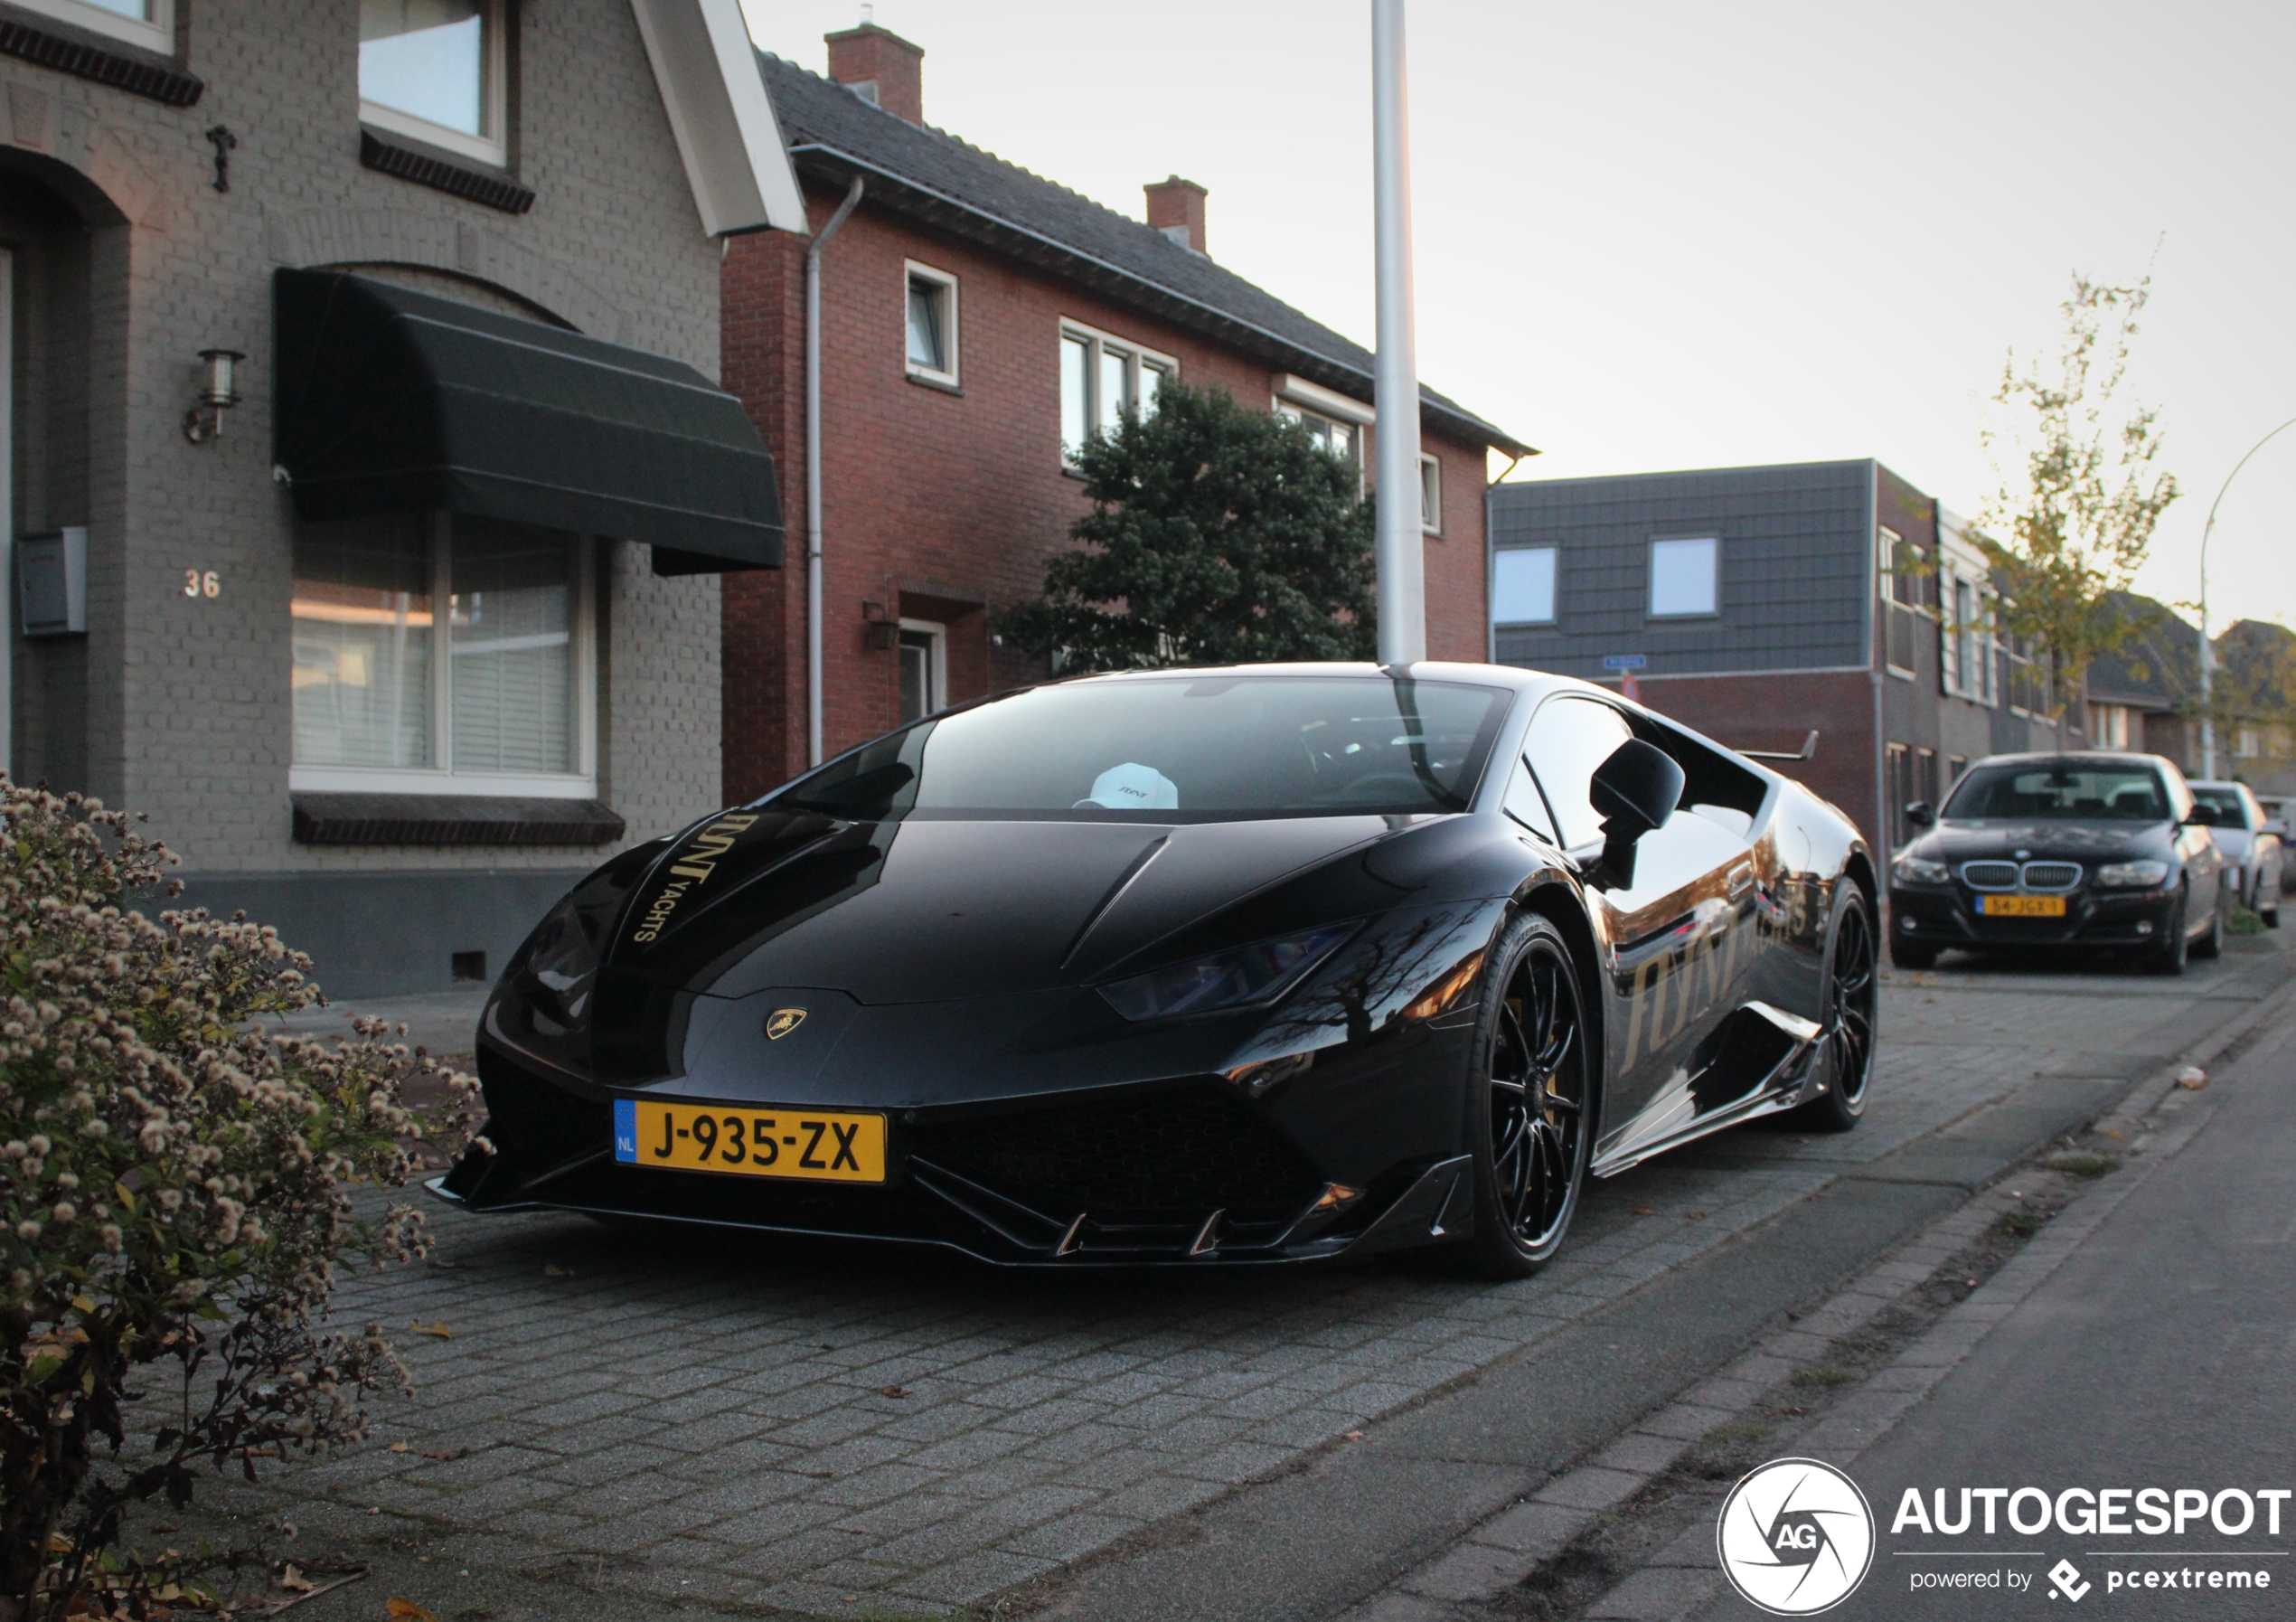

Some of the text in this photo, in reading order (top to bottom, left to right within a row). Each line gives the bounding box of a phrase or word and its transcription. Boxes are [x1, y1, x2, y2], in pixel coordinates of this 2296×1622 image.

[184, 569, 220, 599] 36
[634, 881, 692, 942] YACHTS
[618, 1136, 635, 1153] NL
[654, 1112, 860, 1171] J-935-ZX
